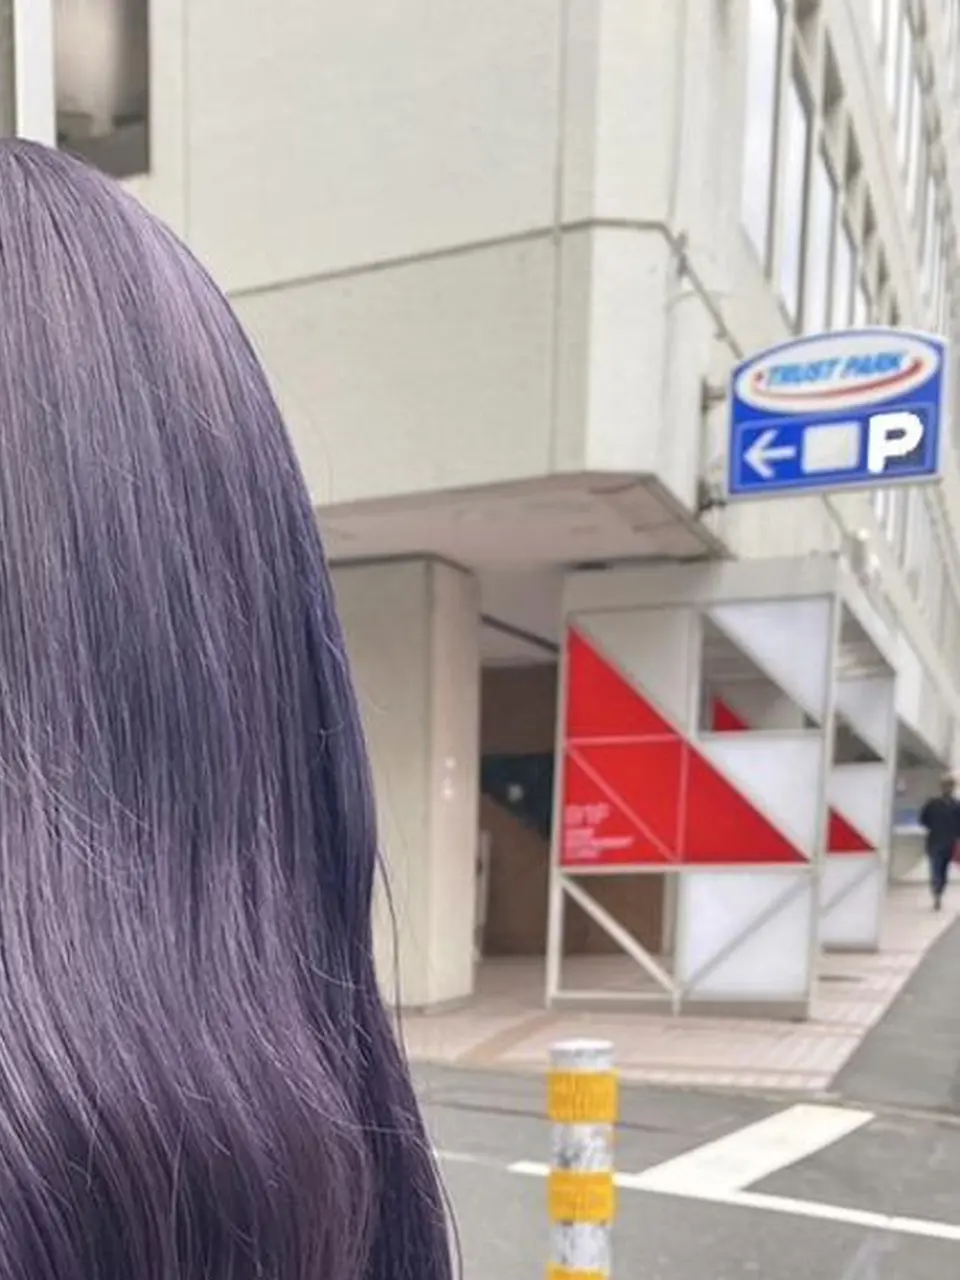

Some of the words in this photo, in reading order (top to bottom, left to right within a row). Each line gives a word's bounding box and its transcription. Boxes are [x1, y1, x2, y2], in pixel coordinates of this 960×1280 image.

[767, 358, 841, 387] TRUST
[841, 350, 907, 378] PARK
[867, 411, 924, 474] P
